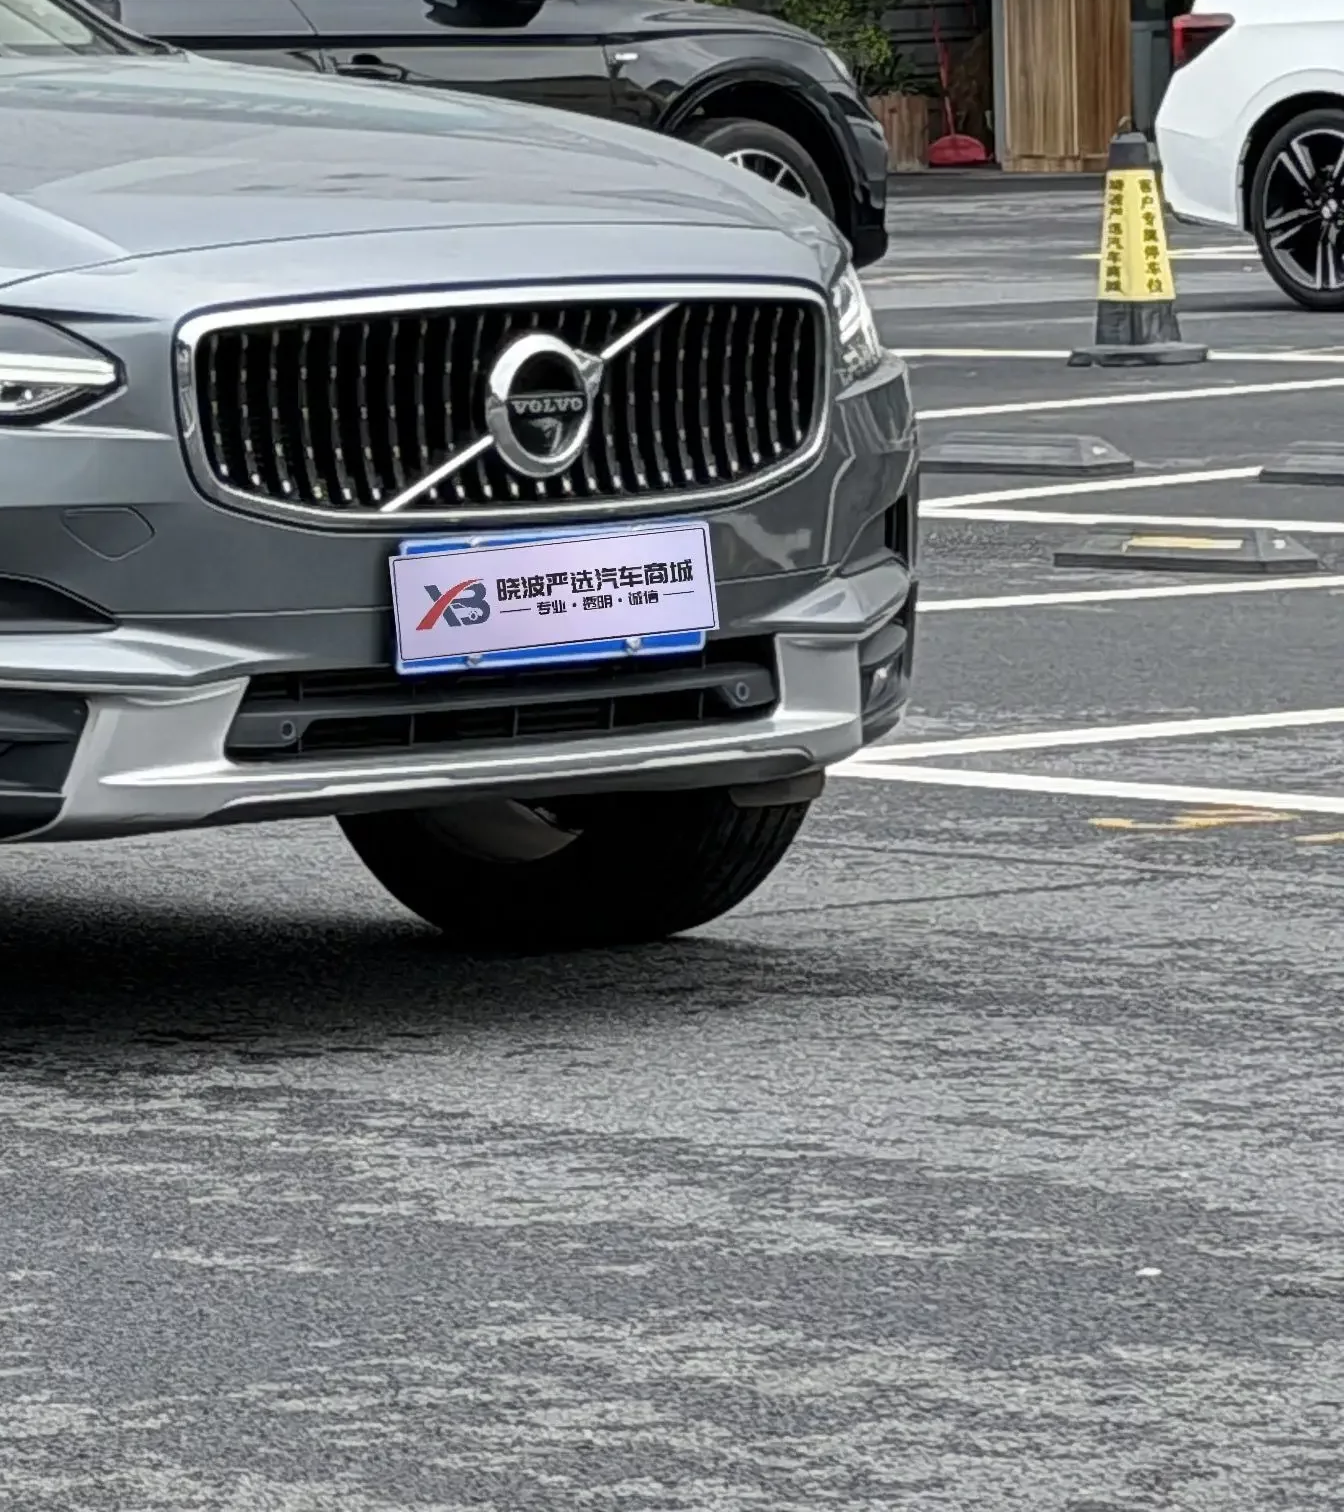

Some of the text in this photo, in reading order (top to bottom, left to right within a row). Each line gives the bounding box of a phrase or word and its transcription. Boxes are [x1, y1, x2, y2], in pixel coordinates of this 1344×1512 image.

[511, 396, 584, 415] VOLVO
[495, 558, 694, 602] 晓波严选汽车商城
